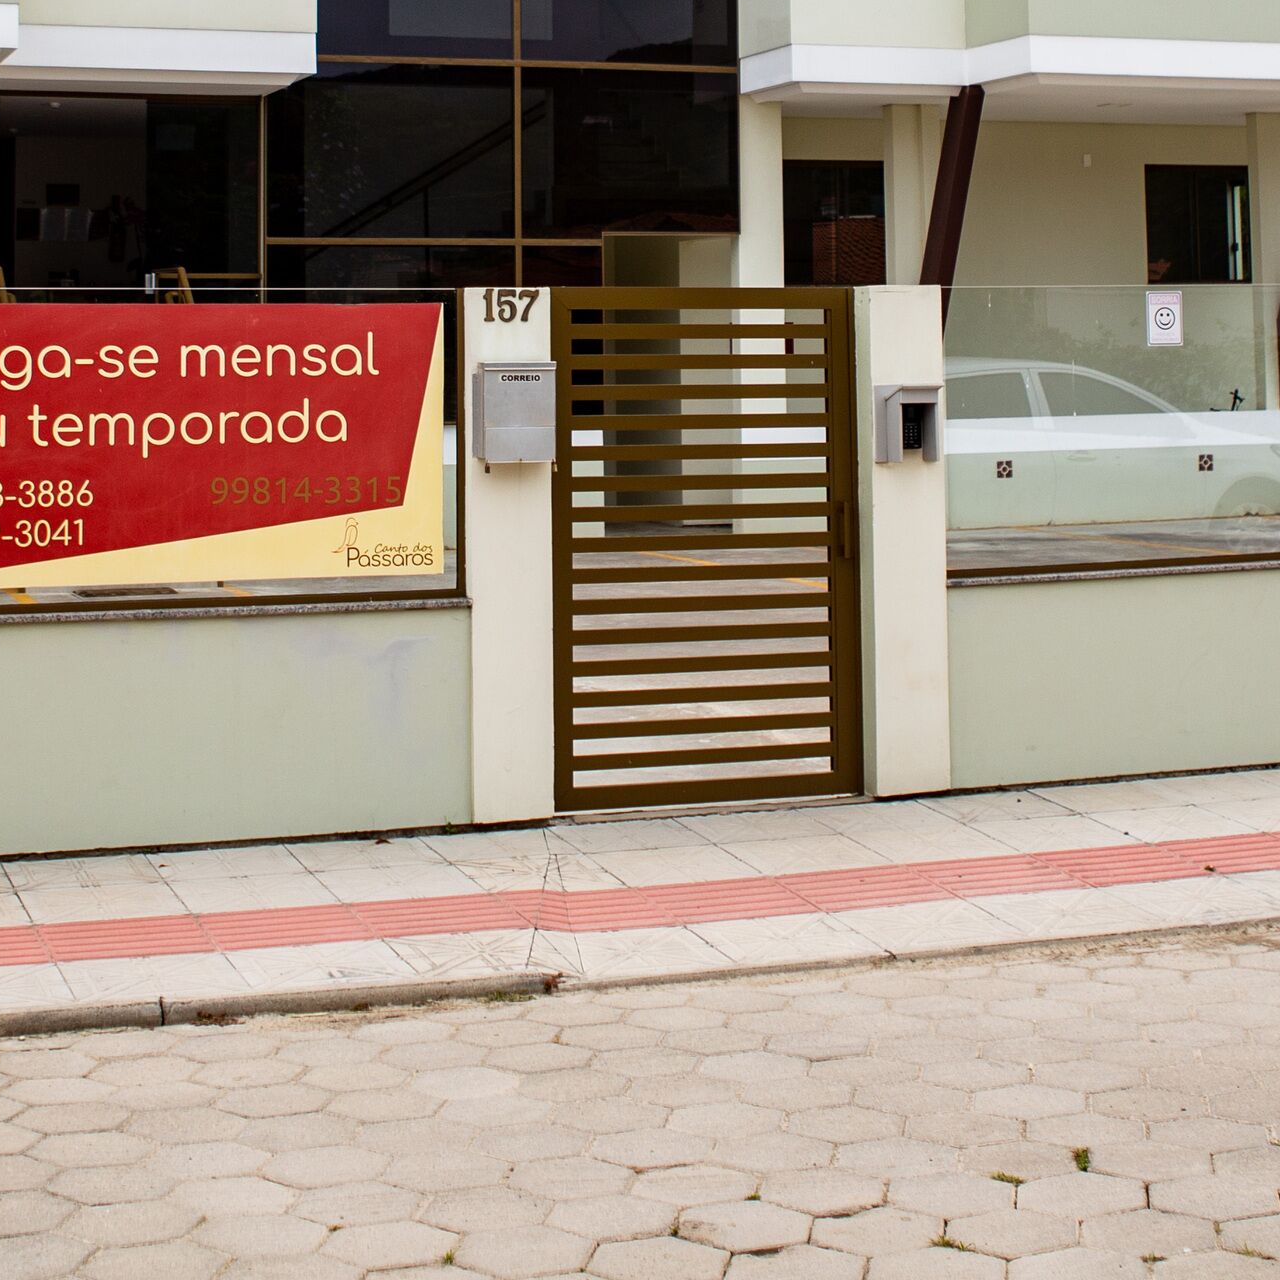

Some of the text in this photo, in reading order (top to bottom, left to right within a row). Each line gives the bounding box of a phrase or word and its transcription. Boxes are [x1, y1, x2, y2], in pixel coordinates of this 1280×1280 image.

[482, 288, 540, 323] 157
[180, 331, 380, 378] mensal
[500, 374, 541, 382] CORREIO
[27, 397, 348, 459] temporada
[210, 475, 402, 505] 99814-3315
[346, 547, 434, 568] Pássaros
[374, 541, 434, 554] Canto dos
